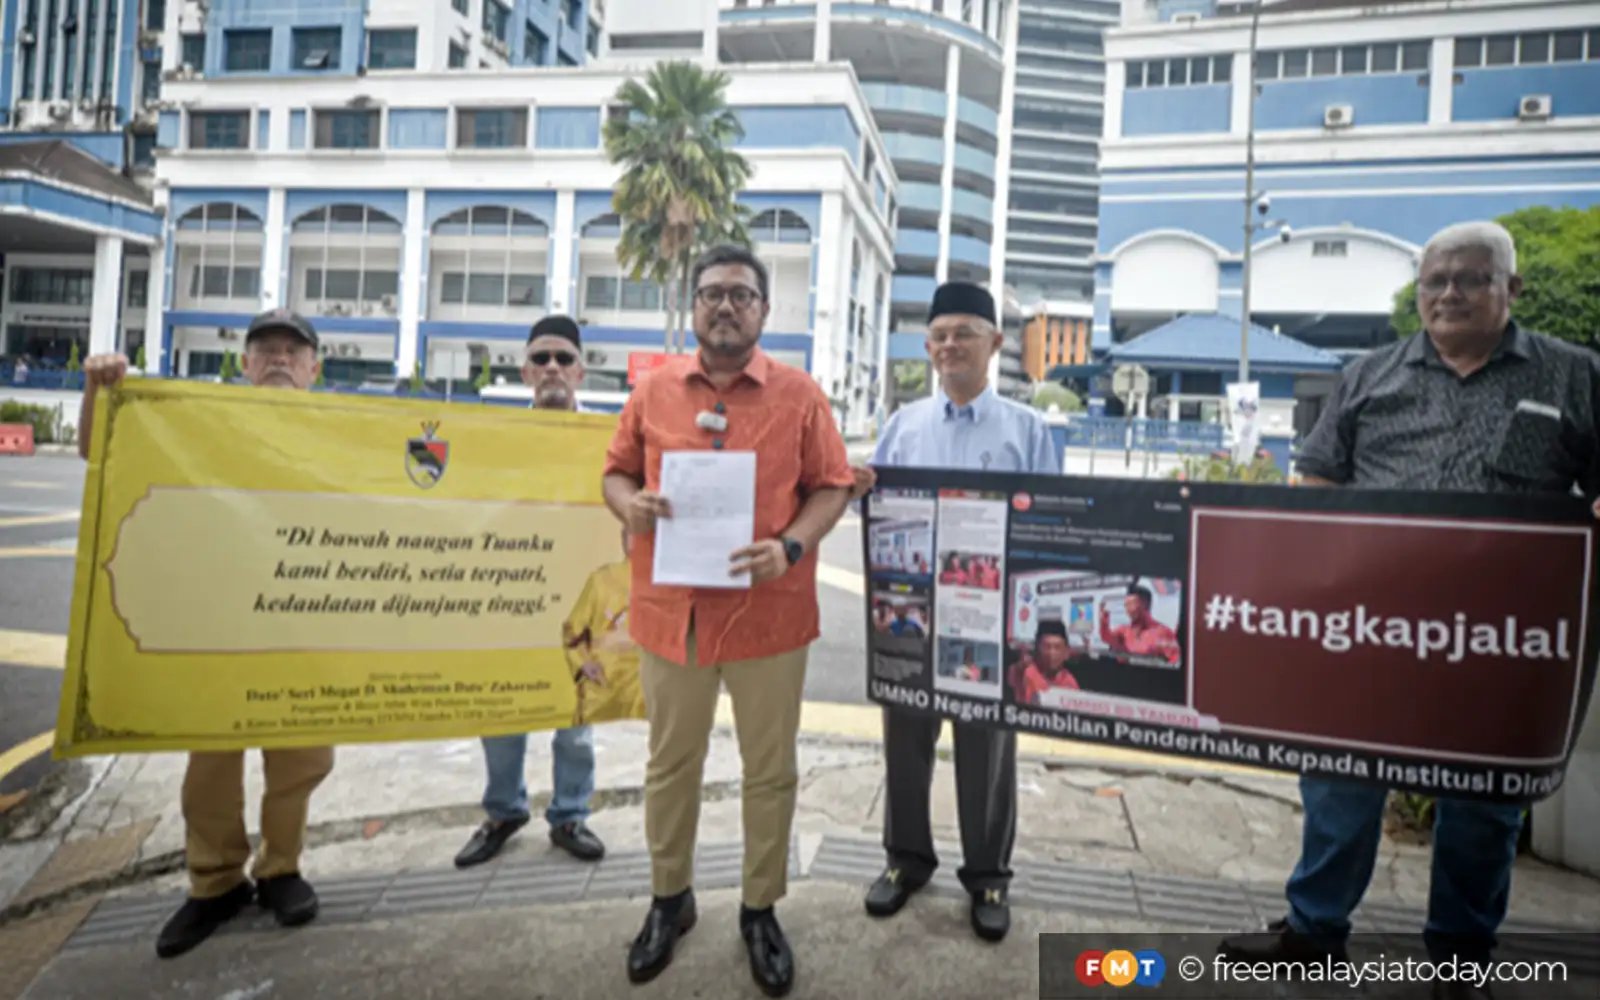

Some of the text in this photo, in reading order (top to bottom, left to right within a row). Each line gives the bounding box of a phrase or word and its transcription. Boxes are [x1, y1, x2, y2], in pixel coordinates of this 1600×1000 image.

[319, 529, 390, 549] bawah
[481, 532, 555, 552] Tuanku
[274, 560, 547, 586] kami berdiri, setia terpatri,
[253, 593, 377, 613] kedaulatan
[382, 594, 482, 617] dijunjung
[1204, 594, 1571, 663] #tangkapjalal
[871, 678, 930, 708] UMNO
[933, 691, 1000, 722] Negeri
[1004, 704, 1109, 739] Sembilan
[1113, 723, 1260, 761] Penderhaka
[1267, 744, 1370, 778] Kepada
[1376, 760, 1494, 791] Institusi
